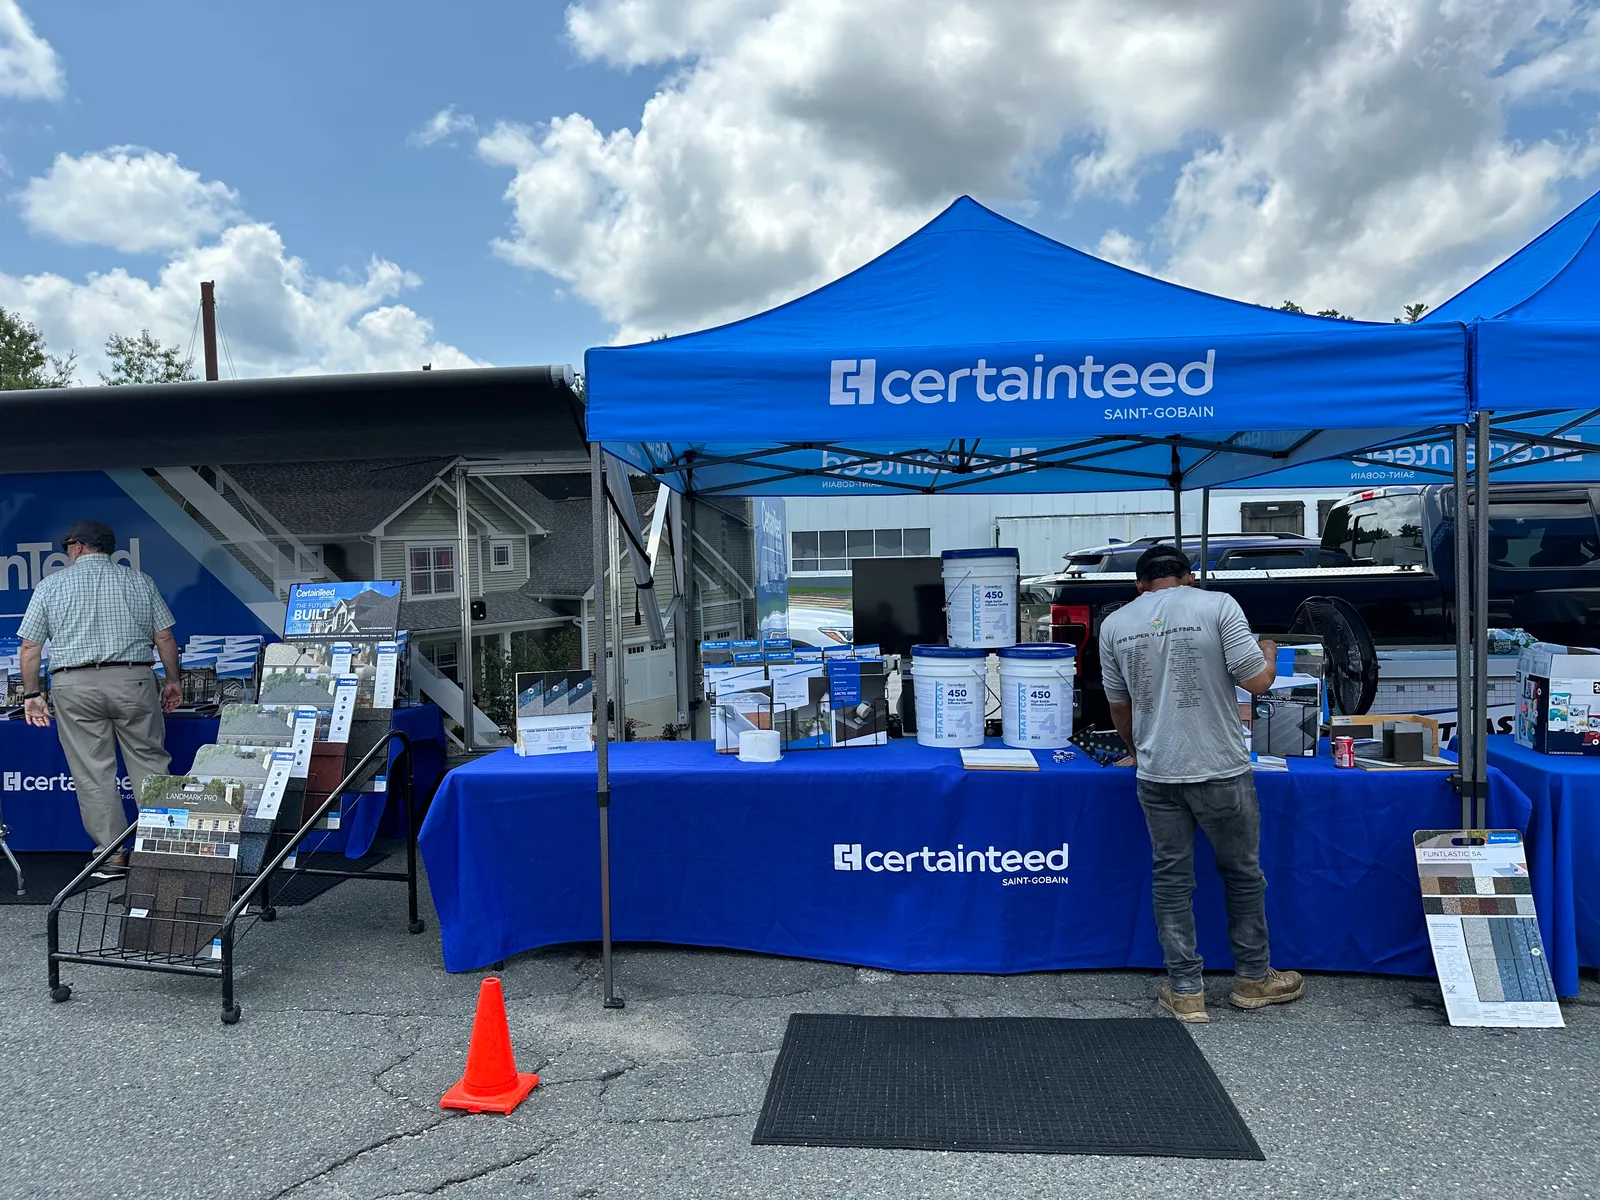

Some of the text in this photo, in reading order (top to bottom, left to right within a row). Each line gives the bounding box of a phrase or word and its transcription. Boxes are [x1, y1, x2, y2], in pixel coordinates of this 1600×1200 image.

[881, 349, 1216, 405] certainteed
[1104, 406, 1214, 420] SAINT-GOBAIN
[296, 588, 336, 598] CertainTeed
[294, 608, 331, 620] BUILT
[166, 793, 202, 801] LANDMARK
[865, 843, 1068, 872] certainteed
[1002, 877, 1068, 886] SAINT-GOBAIN
